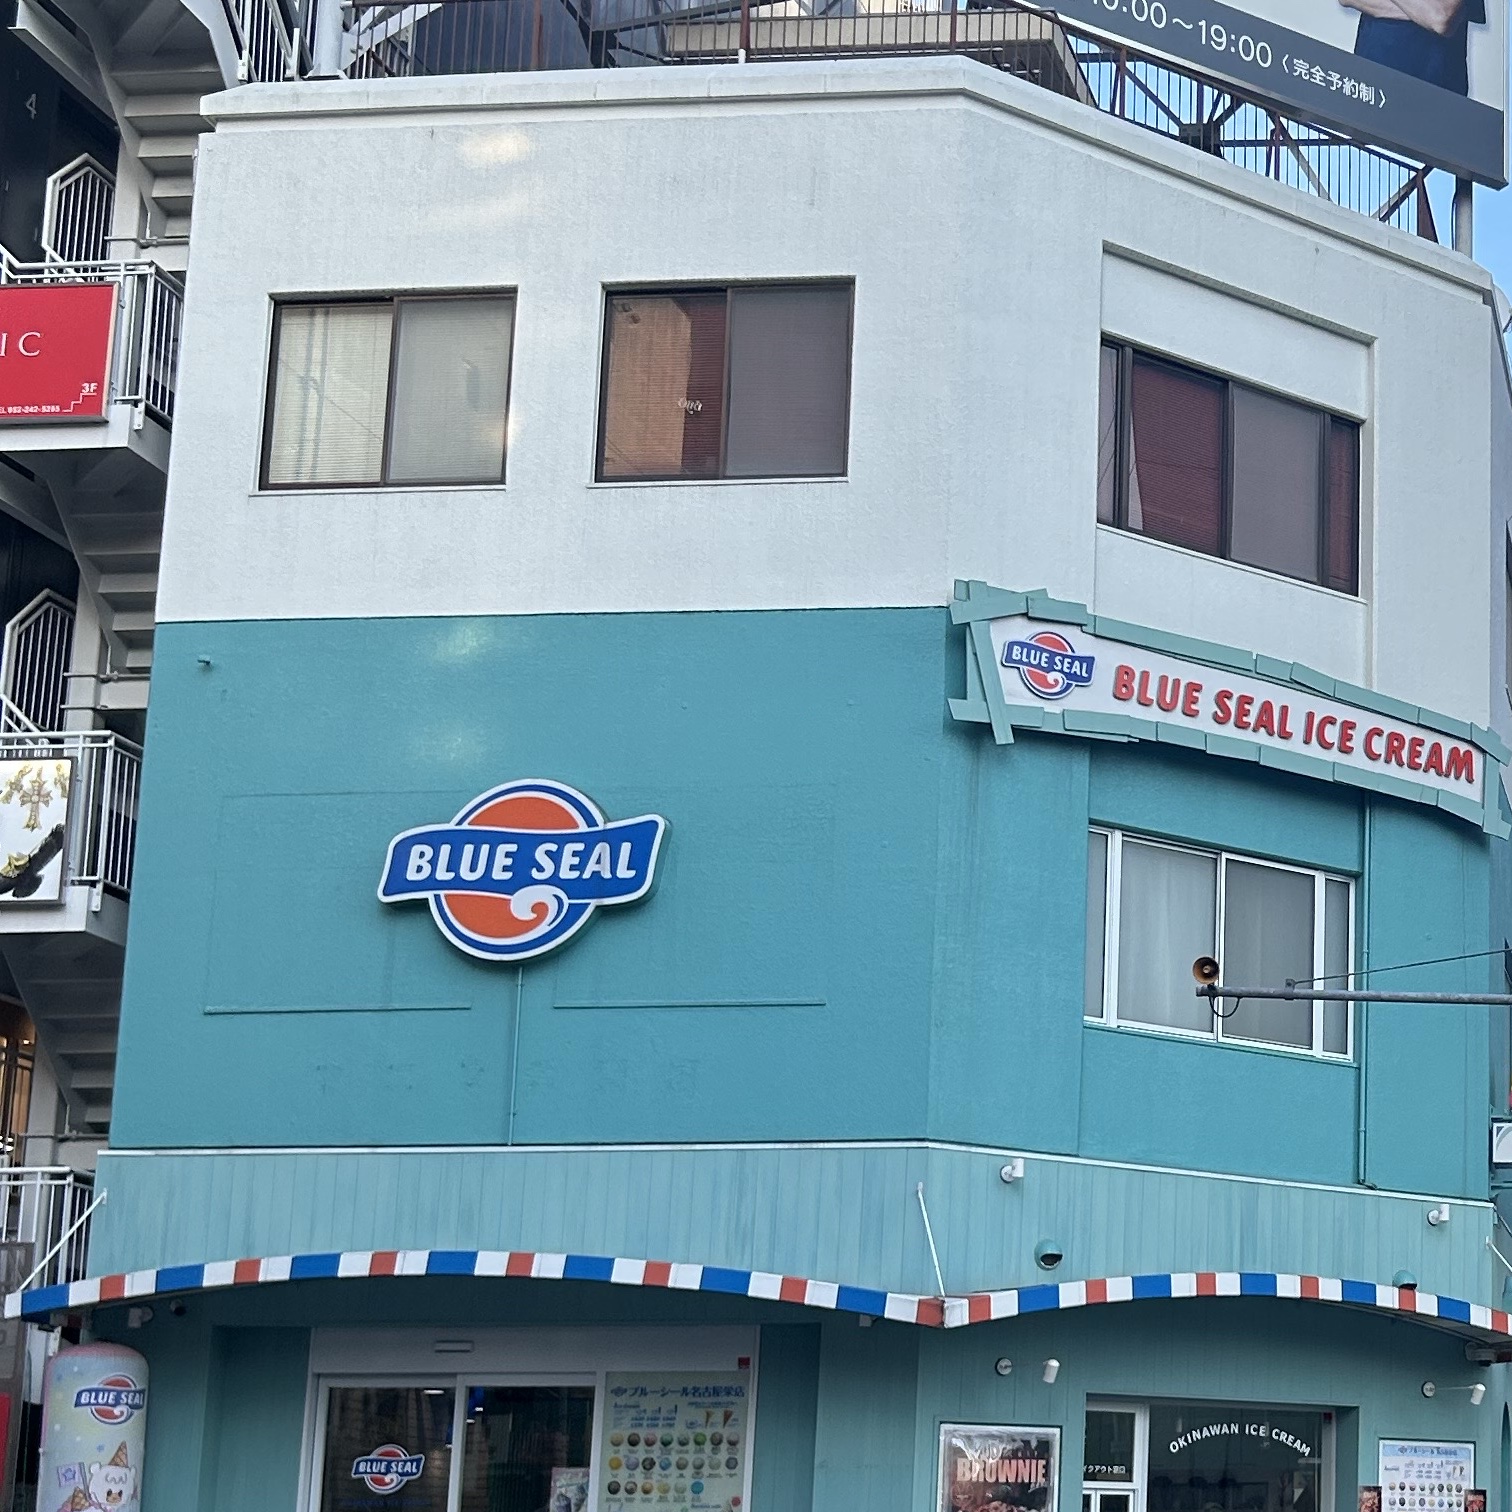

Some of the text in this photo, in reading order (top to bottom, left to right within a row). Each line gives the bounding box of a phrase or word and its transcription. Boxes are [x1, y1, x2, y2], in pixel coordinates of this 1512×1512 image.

[26, 93, 37, 120] 4
[81, 382, 98, 394] 3F
[1011, 645, 1089, 678] BLUE SEAL
[1112, 663, 1477, 786] BLUE SEAL ICE CREAM
[405, 841, 637, 882] BLUE SEAL
[80, 1391, 115, 1405] BLUE
[1169, 1422, 1312, 1457] OKINAWAN ICE CREAM
[358, 1459, 418, 1473] BLUE SEAL
[956, 1458, 1046, 1483] BROWNIE
